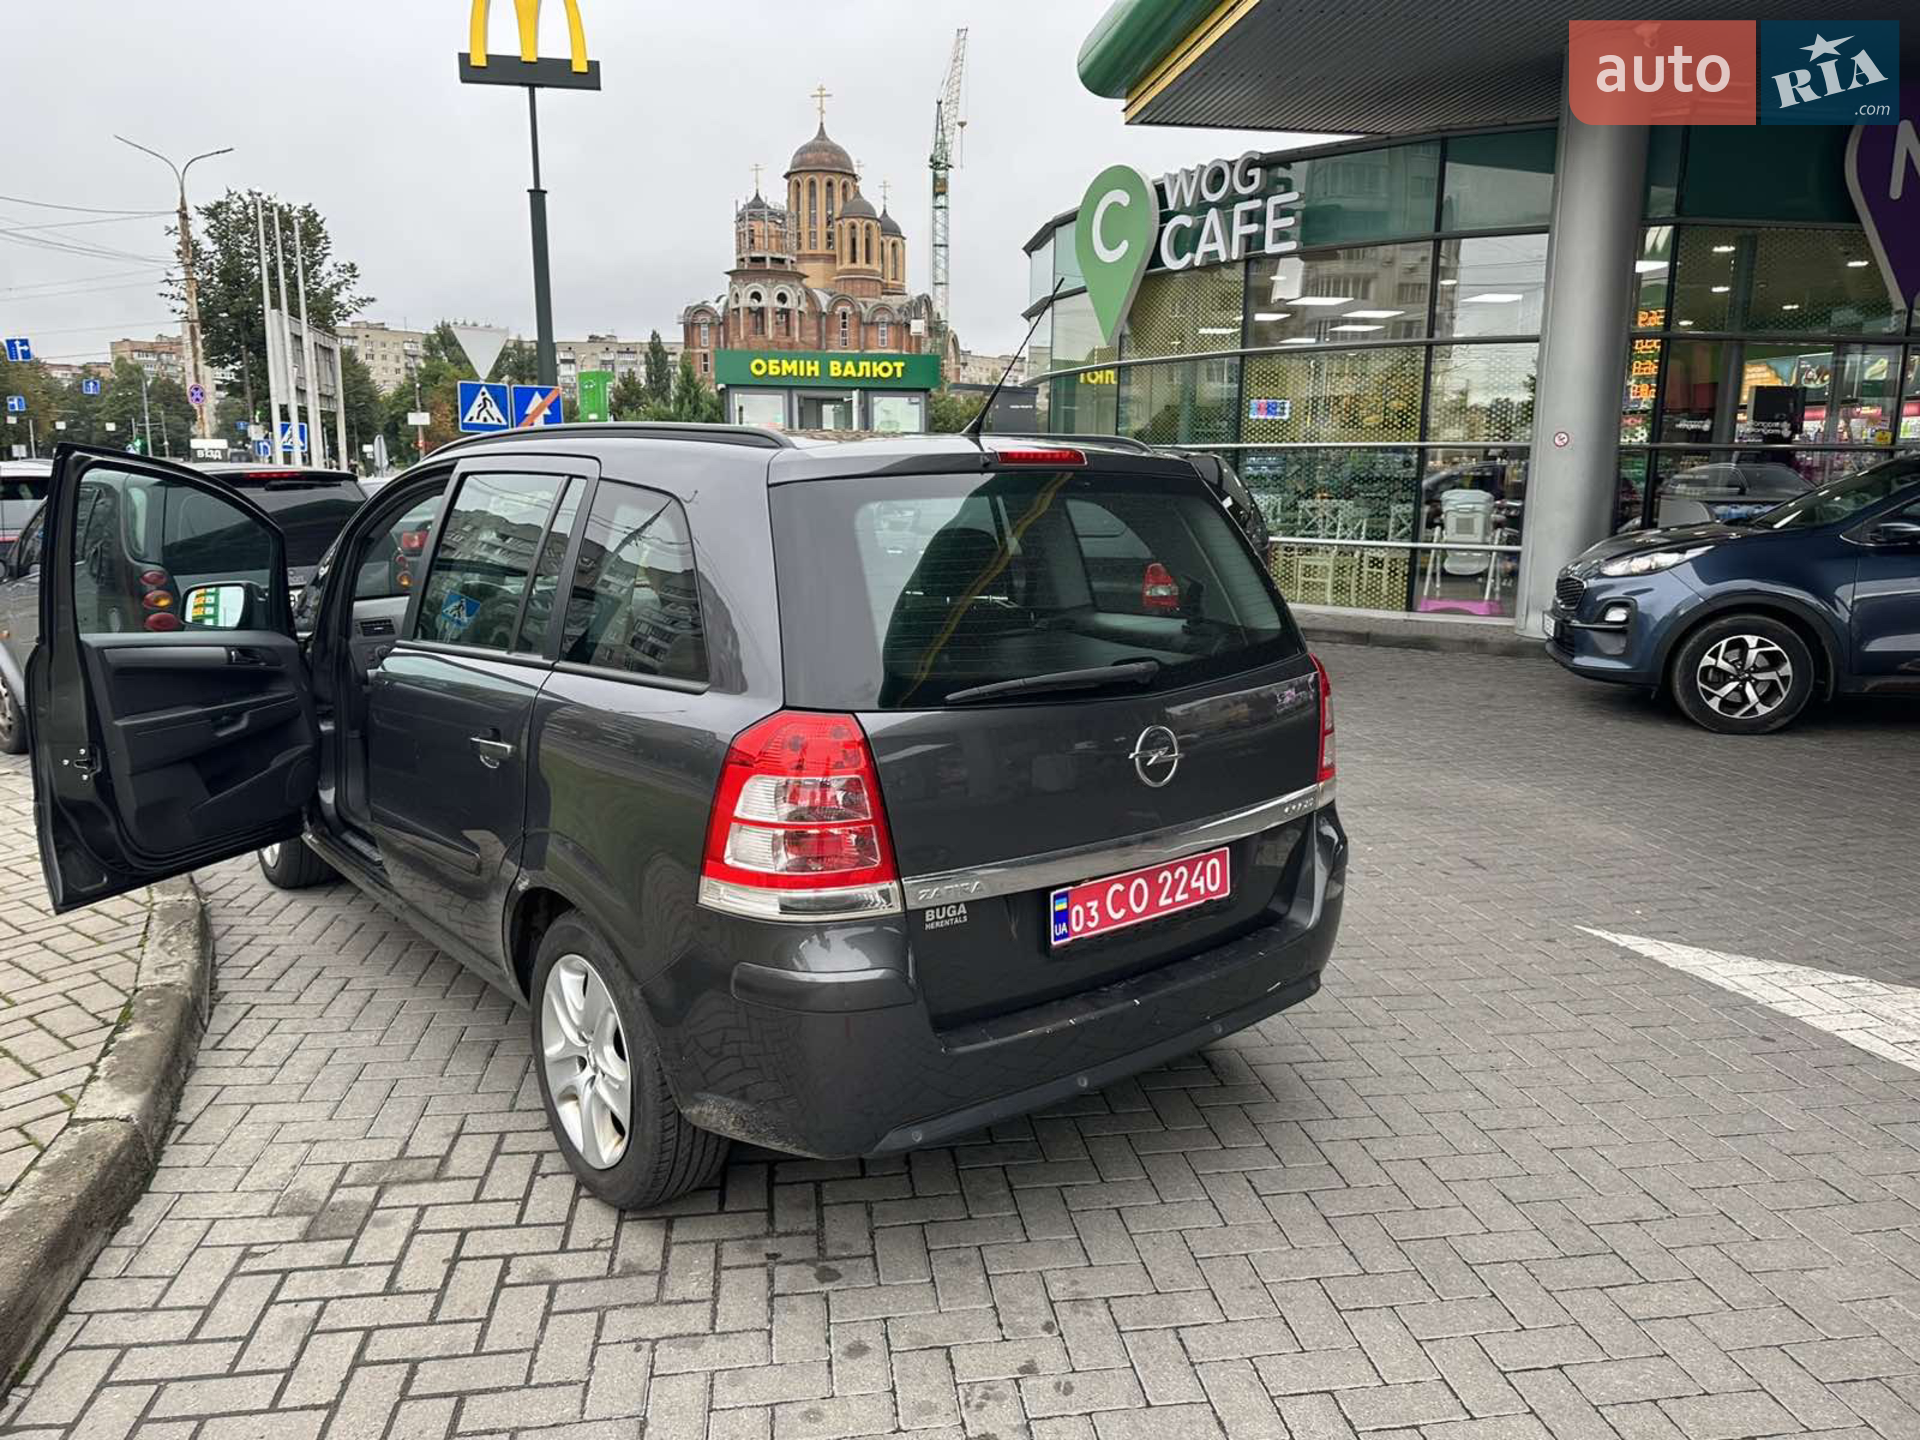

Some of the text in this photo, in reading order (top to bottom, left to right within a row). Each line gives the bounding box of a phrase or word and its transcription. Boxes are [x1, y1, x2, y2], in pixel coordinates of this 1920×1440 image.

[1162, 151, 1265, 211] WOG
[1091, 188, 1131, 263] C
[1160, 191, 1301, 270] CAFE
[749, 357, 905, 379] ОБМІН ВАЛЮТ
[924, 902, 967, 922] BUGA
[1071, 857, 1221, 932] 03 CO 2240
[1054, 922, 1068, 936] UA
